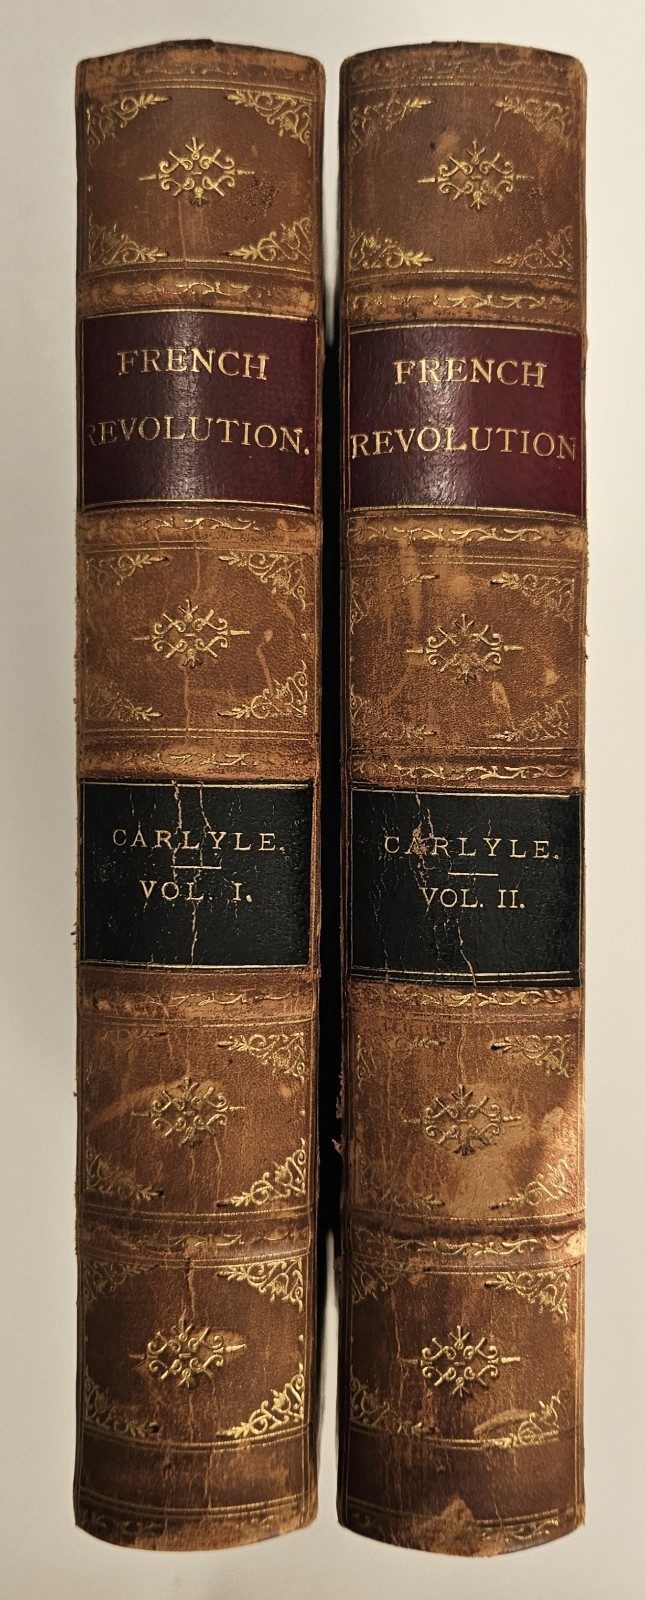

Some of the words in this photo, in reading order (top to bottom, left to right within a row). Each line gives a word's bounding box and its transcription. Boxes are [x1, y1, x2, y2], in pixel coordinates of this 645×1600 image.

[117, 347, 270, 381] FRENCH
[393, 358, 547, 388] FRENCH
[350, 425, 576, 461] REVOLUTION
[112, 828, 285, 853] CARLYLE.
[384, 835, 559, 859] CARLYLE.
[233, 882, 252, 903] I.
[420, 887, 484, 908] VOL.
[497, 889, 525, 909] II.
